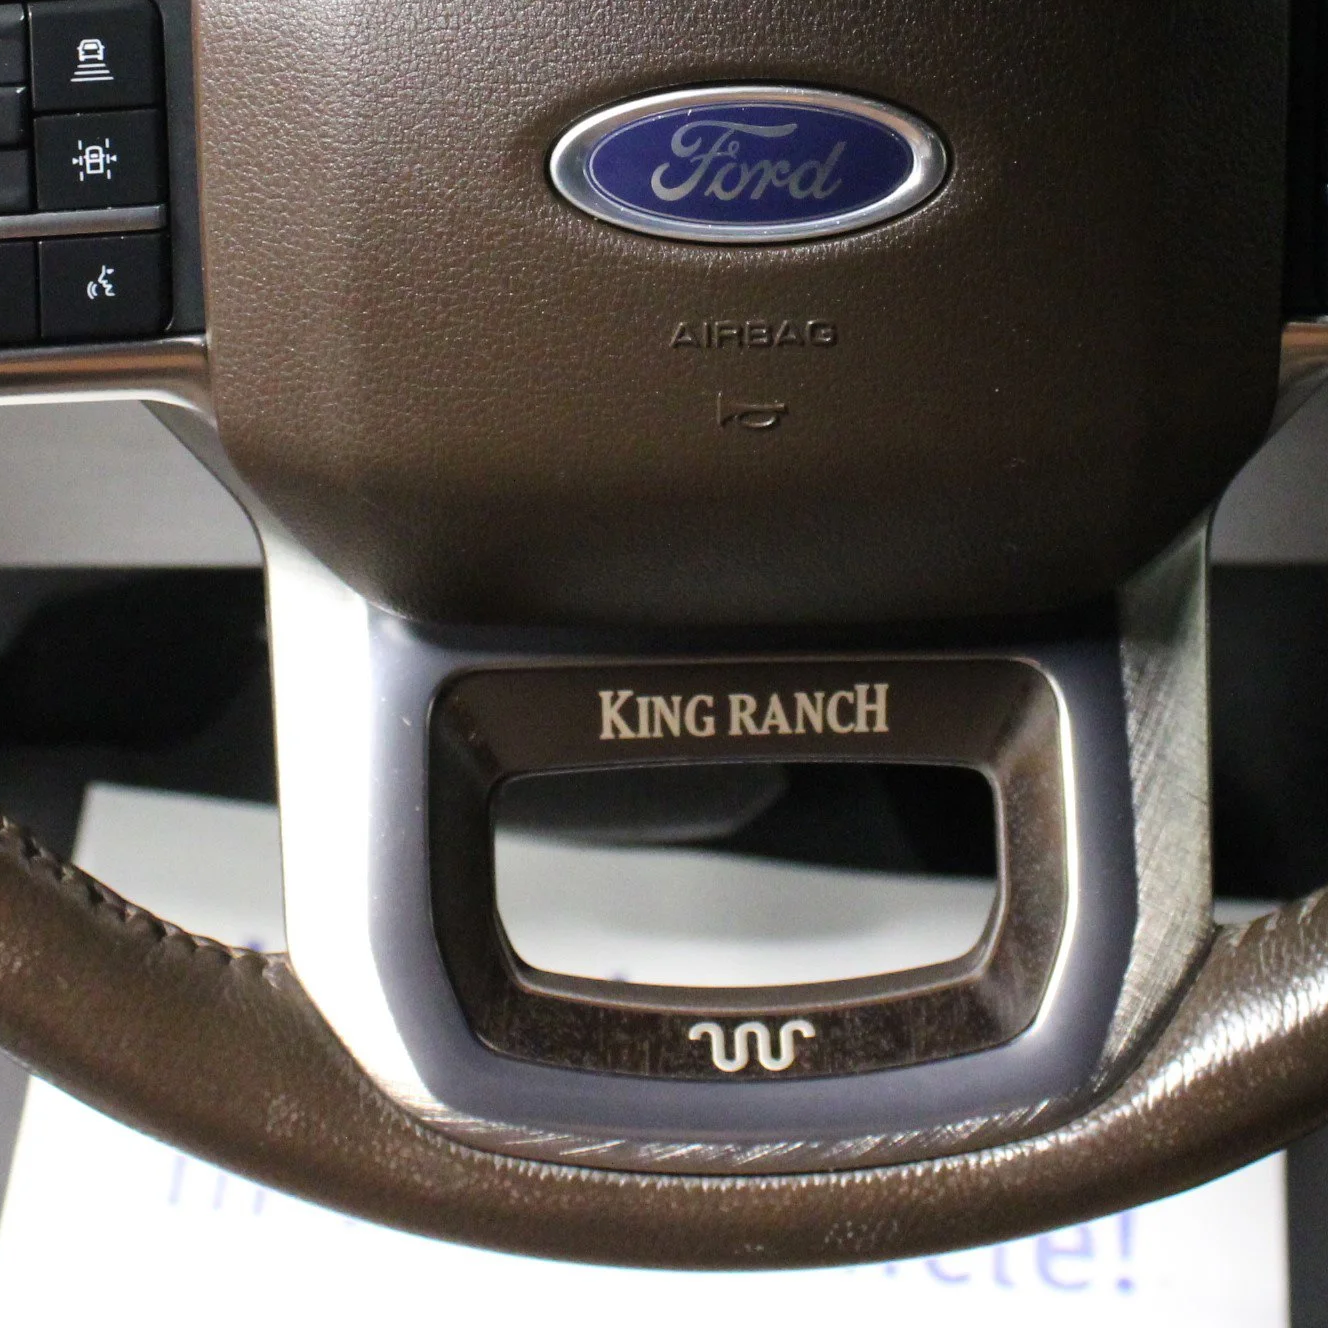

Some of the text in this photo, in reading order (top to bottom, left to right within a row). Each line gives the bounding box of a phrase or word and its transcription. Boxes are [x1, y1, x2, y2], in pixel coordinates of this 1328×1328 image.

[650, 119, 847, 202] Ford
[670, 319, 839, 349] AIRBAG
[598, 682, 890, 740] KING RANCH
